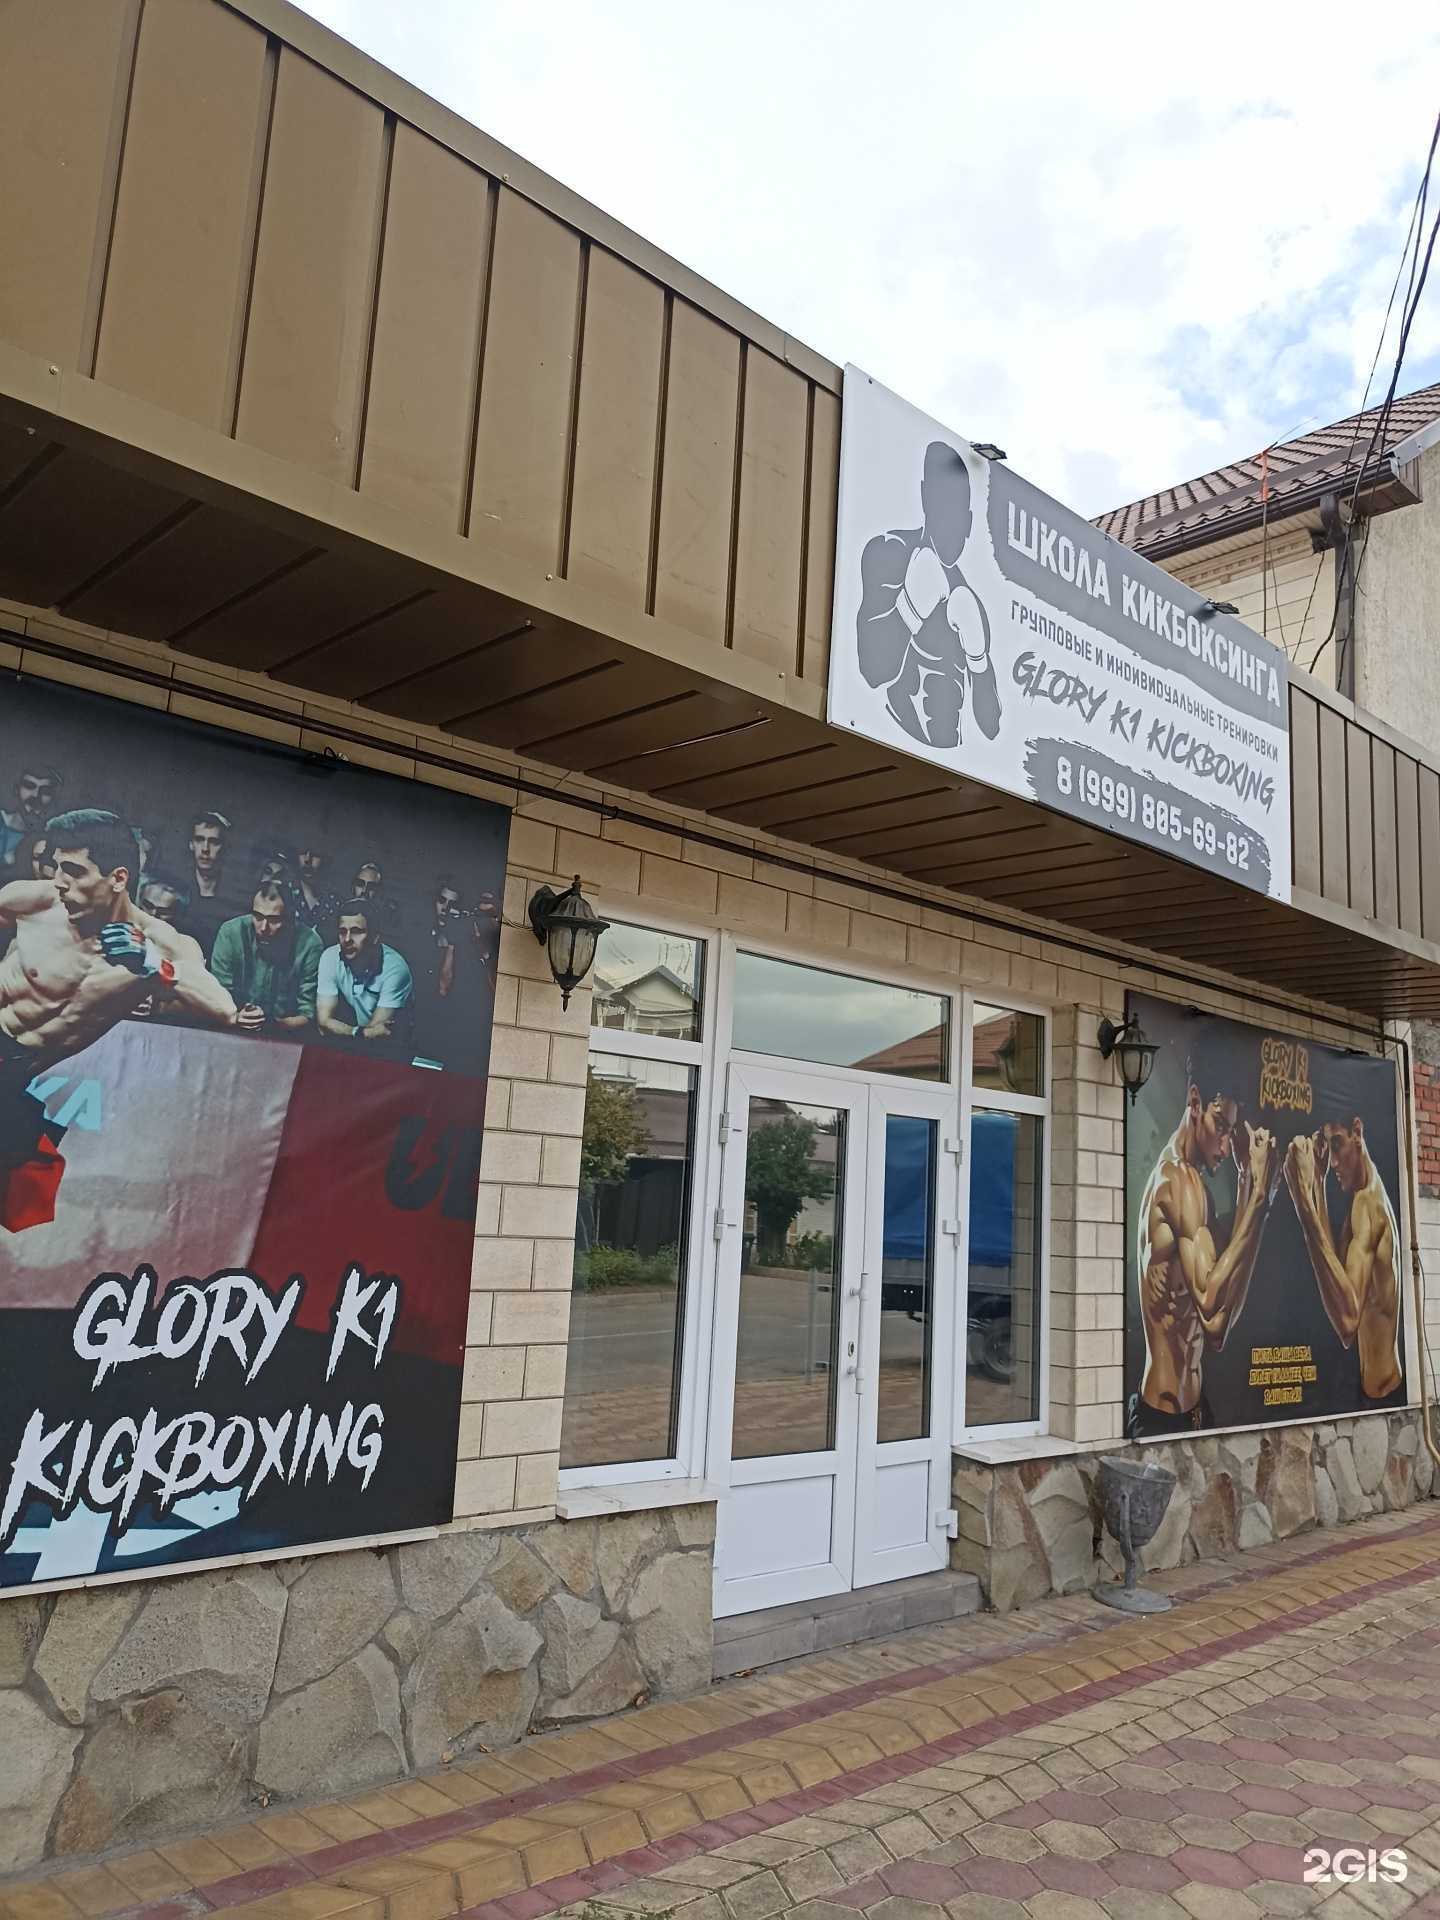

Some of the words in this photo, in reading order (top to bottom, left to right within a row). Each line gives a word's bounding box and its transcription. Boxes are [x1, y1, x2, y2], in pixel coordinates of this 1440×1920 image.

[1008, 500, 1111, 606] ШКОЛА
[1122, 574, 1281, 708] КИКБОКСИНГА
[1011, 600, 1092, 662] ГРУППОВЫЕ
[1095, 646, 1103, 666] И
[1106, 653, 1214, 727] ИНДИВИДУАЛЬНЫЕ
[1217, 714, 1279, 763] ТРЕНИРОВКИ
[1012, 651, 1108, 724] GLORY
[1109, 699, 1143, 744] K1
[1147, 717, 1275, 815] KICKBOXING
[1057, 756, 1072, 795] 8
[1078, 764, 1136, 823] (999)
[1142, 793, 1249, 870] 805-69-82
[73, 1273, 301, 1391] GLORY
[326, 1269, 398, 1382] K1
[1, 1401, 385, 1540] KICKBOXING
